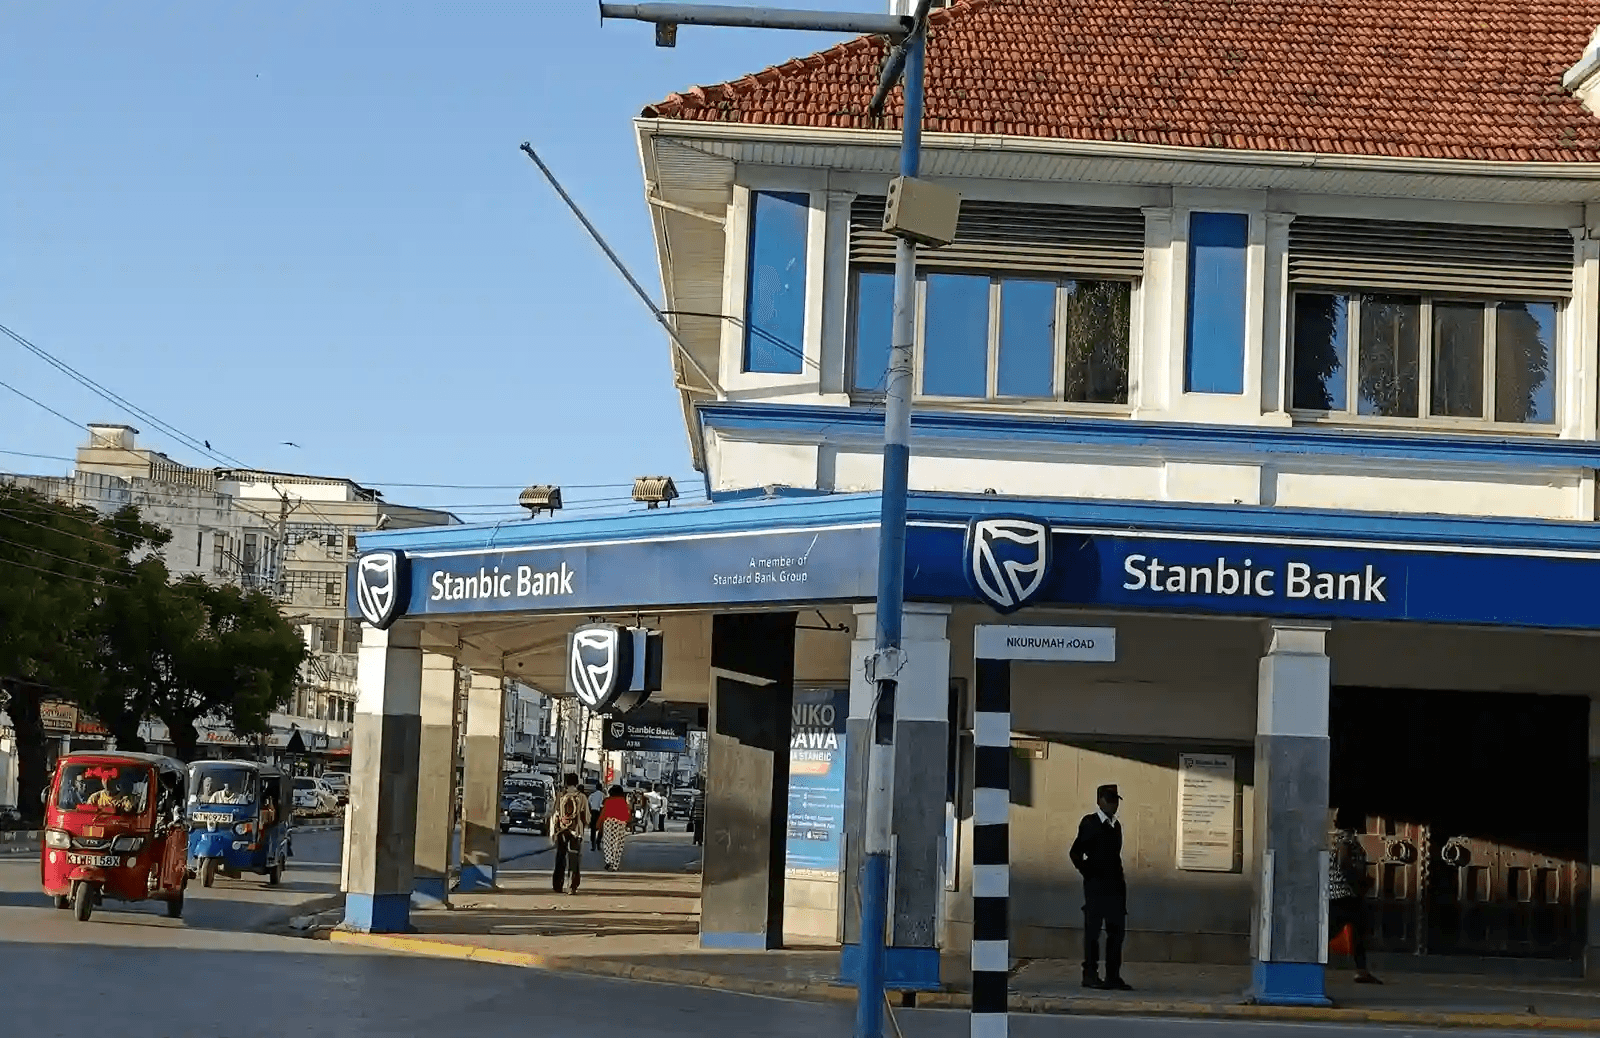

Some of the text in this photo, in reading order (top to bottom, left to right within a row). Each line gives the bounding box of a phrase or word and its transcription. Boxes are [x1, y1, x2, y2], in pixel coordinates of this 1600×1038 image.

[749, 556, 808, 568] A member of
[430, 561, 575, 600] Stanbic Bank
[713, 571, 808, 585] Standard Bank Group
[1123, 554, 1387, 602] Stanbic Bank
[1006, 637, 1095, 649] NKURUMAH ROAD
[791, 703, 836, 726] NIKO
[627, 725, 676, 736] Stanbic Bank
[799, 751, 832, 761] STANBIC
